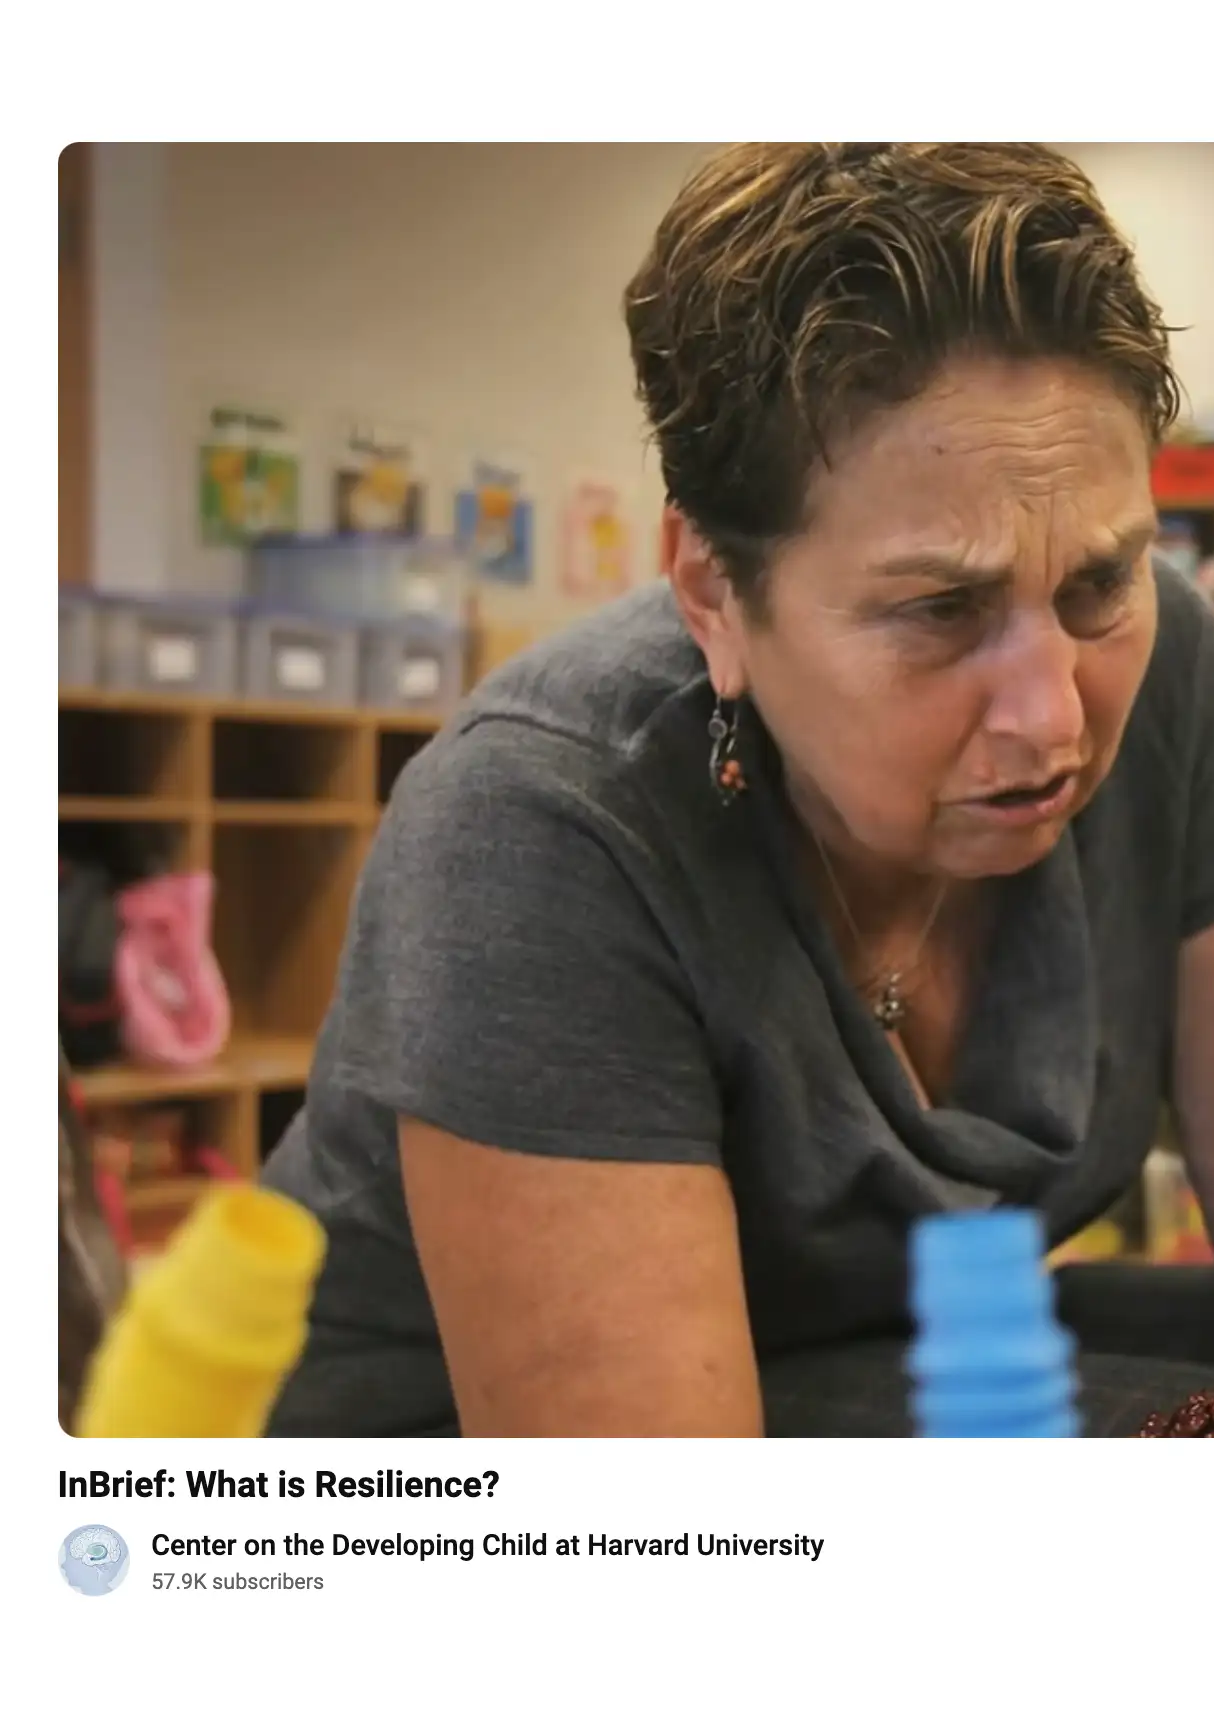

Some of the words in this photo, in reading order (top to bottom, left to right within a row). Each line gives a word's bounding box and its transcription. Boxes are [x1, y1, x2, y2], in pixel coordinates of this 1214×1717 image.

[59, 1469, 176, 1499] InBrief:
[185, 1469, 269, 1499] What
[278, 1469, 306, 1499] is
[315, 1469, 500, 1499] Resilience?
[151, 1533, 238, 1556] Center
[243, 1538, 276, 1556] on
[282, 1532, 325, 1556] the
[332, 1532, 475, 1562] Developing
[482, 1532, 547, 1557] Child
[555, 1534, 581, 1556] at
[588, 1532, 689, 1556] Harvard
[697, 1533, 825, 1562] University
[151, 1572, 208, 1590] 57.9K
[212, 1571, 324, 1590] subscribers
